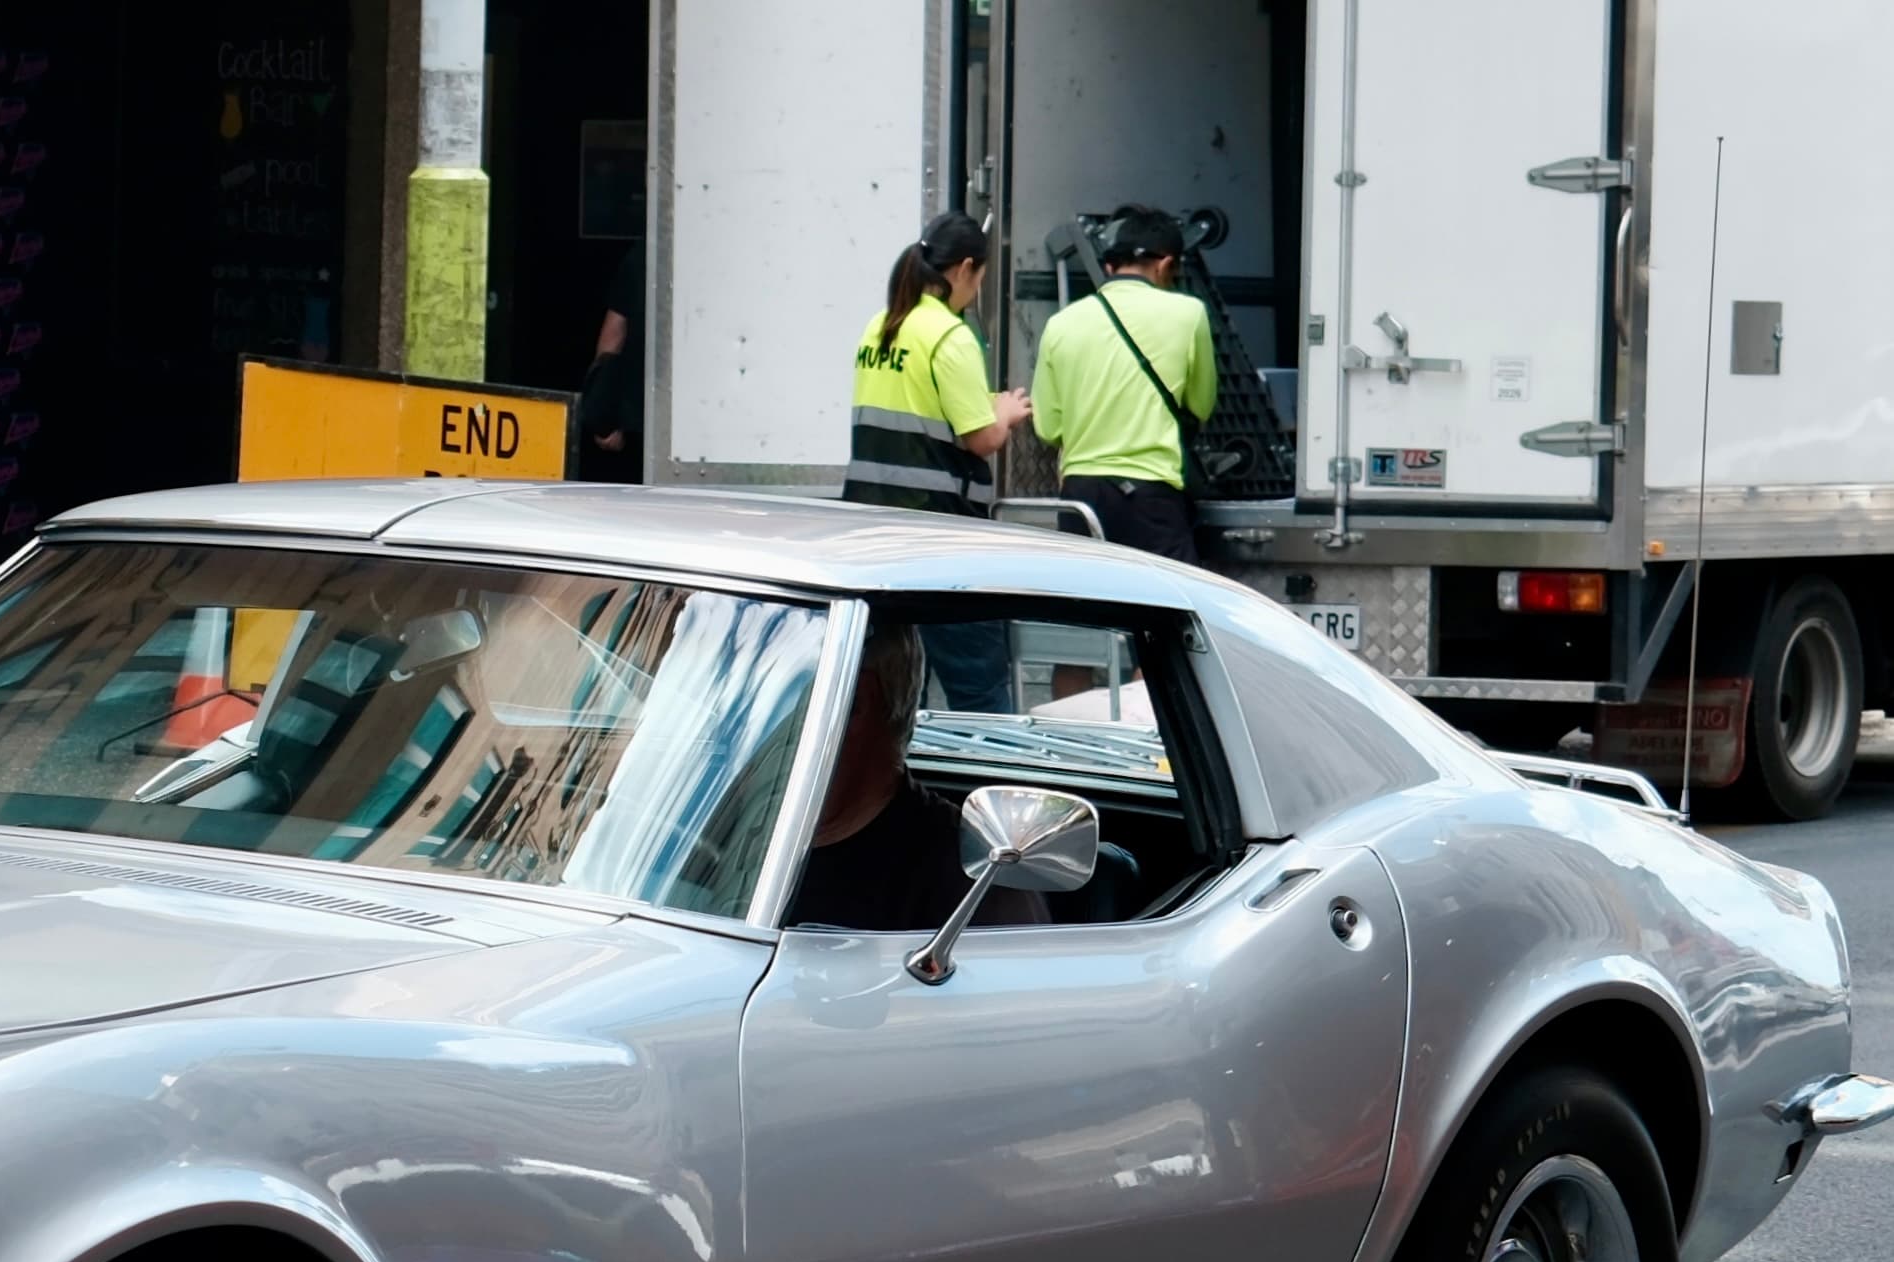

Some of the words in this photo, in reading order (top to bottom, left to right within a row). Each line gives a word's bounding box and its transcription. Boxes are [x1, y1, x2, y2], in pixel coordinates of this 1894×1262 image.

[218, 34, 329, 81] Cocktail
[250, 85, 306, 127] Bar
[265, 152, 329, 198] pool
[441, 405, 520, 459] END
